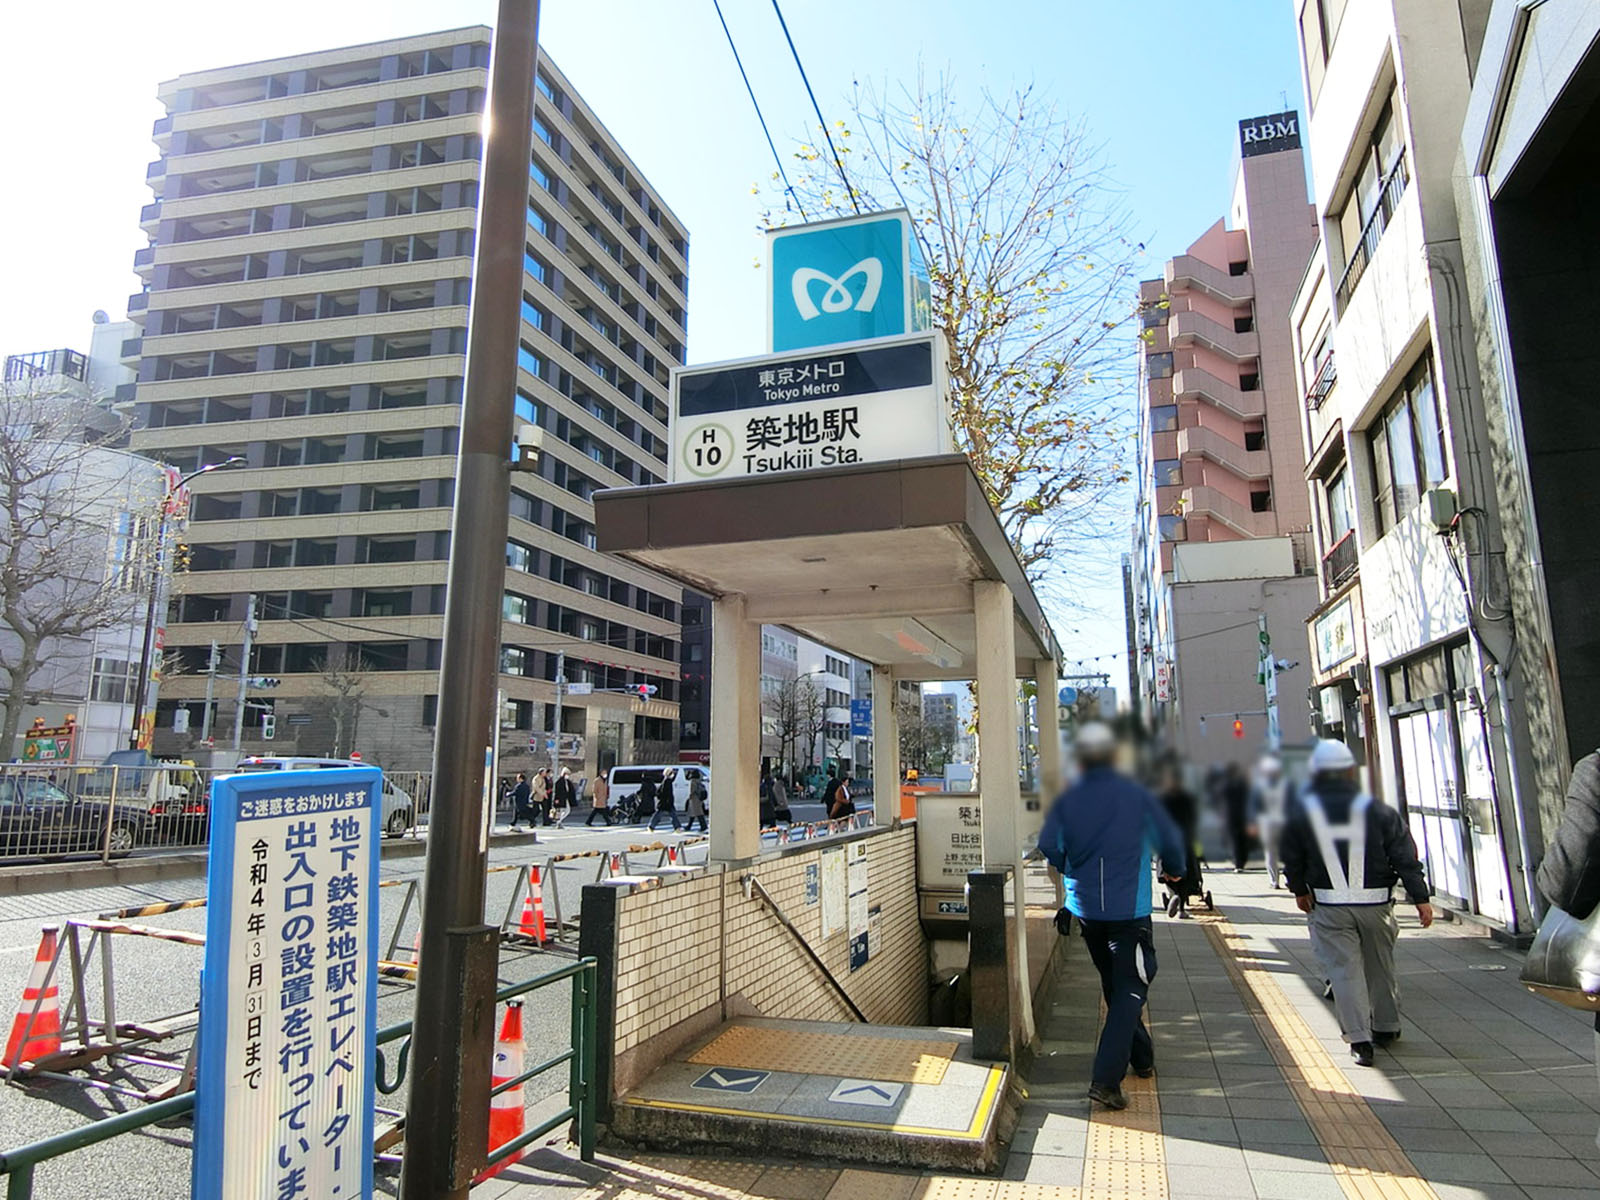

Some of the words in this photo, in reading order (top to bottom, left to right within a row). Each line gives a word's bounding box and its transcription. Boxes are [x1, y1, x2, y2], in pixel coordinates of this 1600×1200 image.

[1243, 120, 1297, 144] RBM
[758, 361, 845, 387] 東京メトロ
[764, 387, 800, 401] Tokyo
[802, 383, 840, 397] Metro
[702, 429, 715, 444] H
[746, 406, 861, 451] 築地駅
[694, 446, 722, 466] 10
[743, 448, 813, 473] Tsukiji
[820, 445, 863, 466] Sta.
[240, 789, 367, 818] ご迷惑をおかけします
[243, 838, 269, 1090] 令和4年3月31日まで
